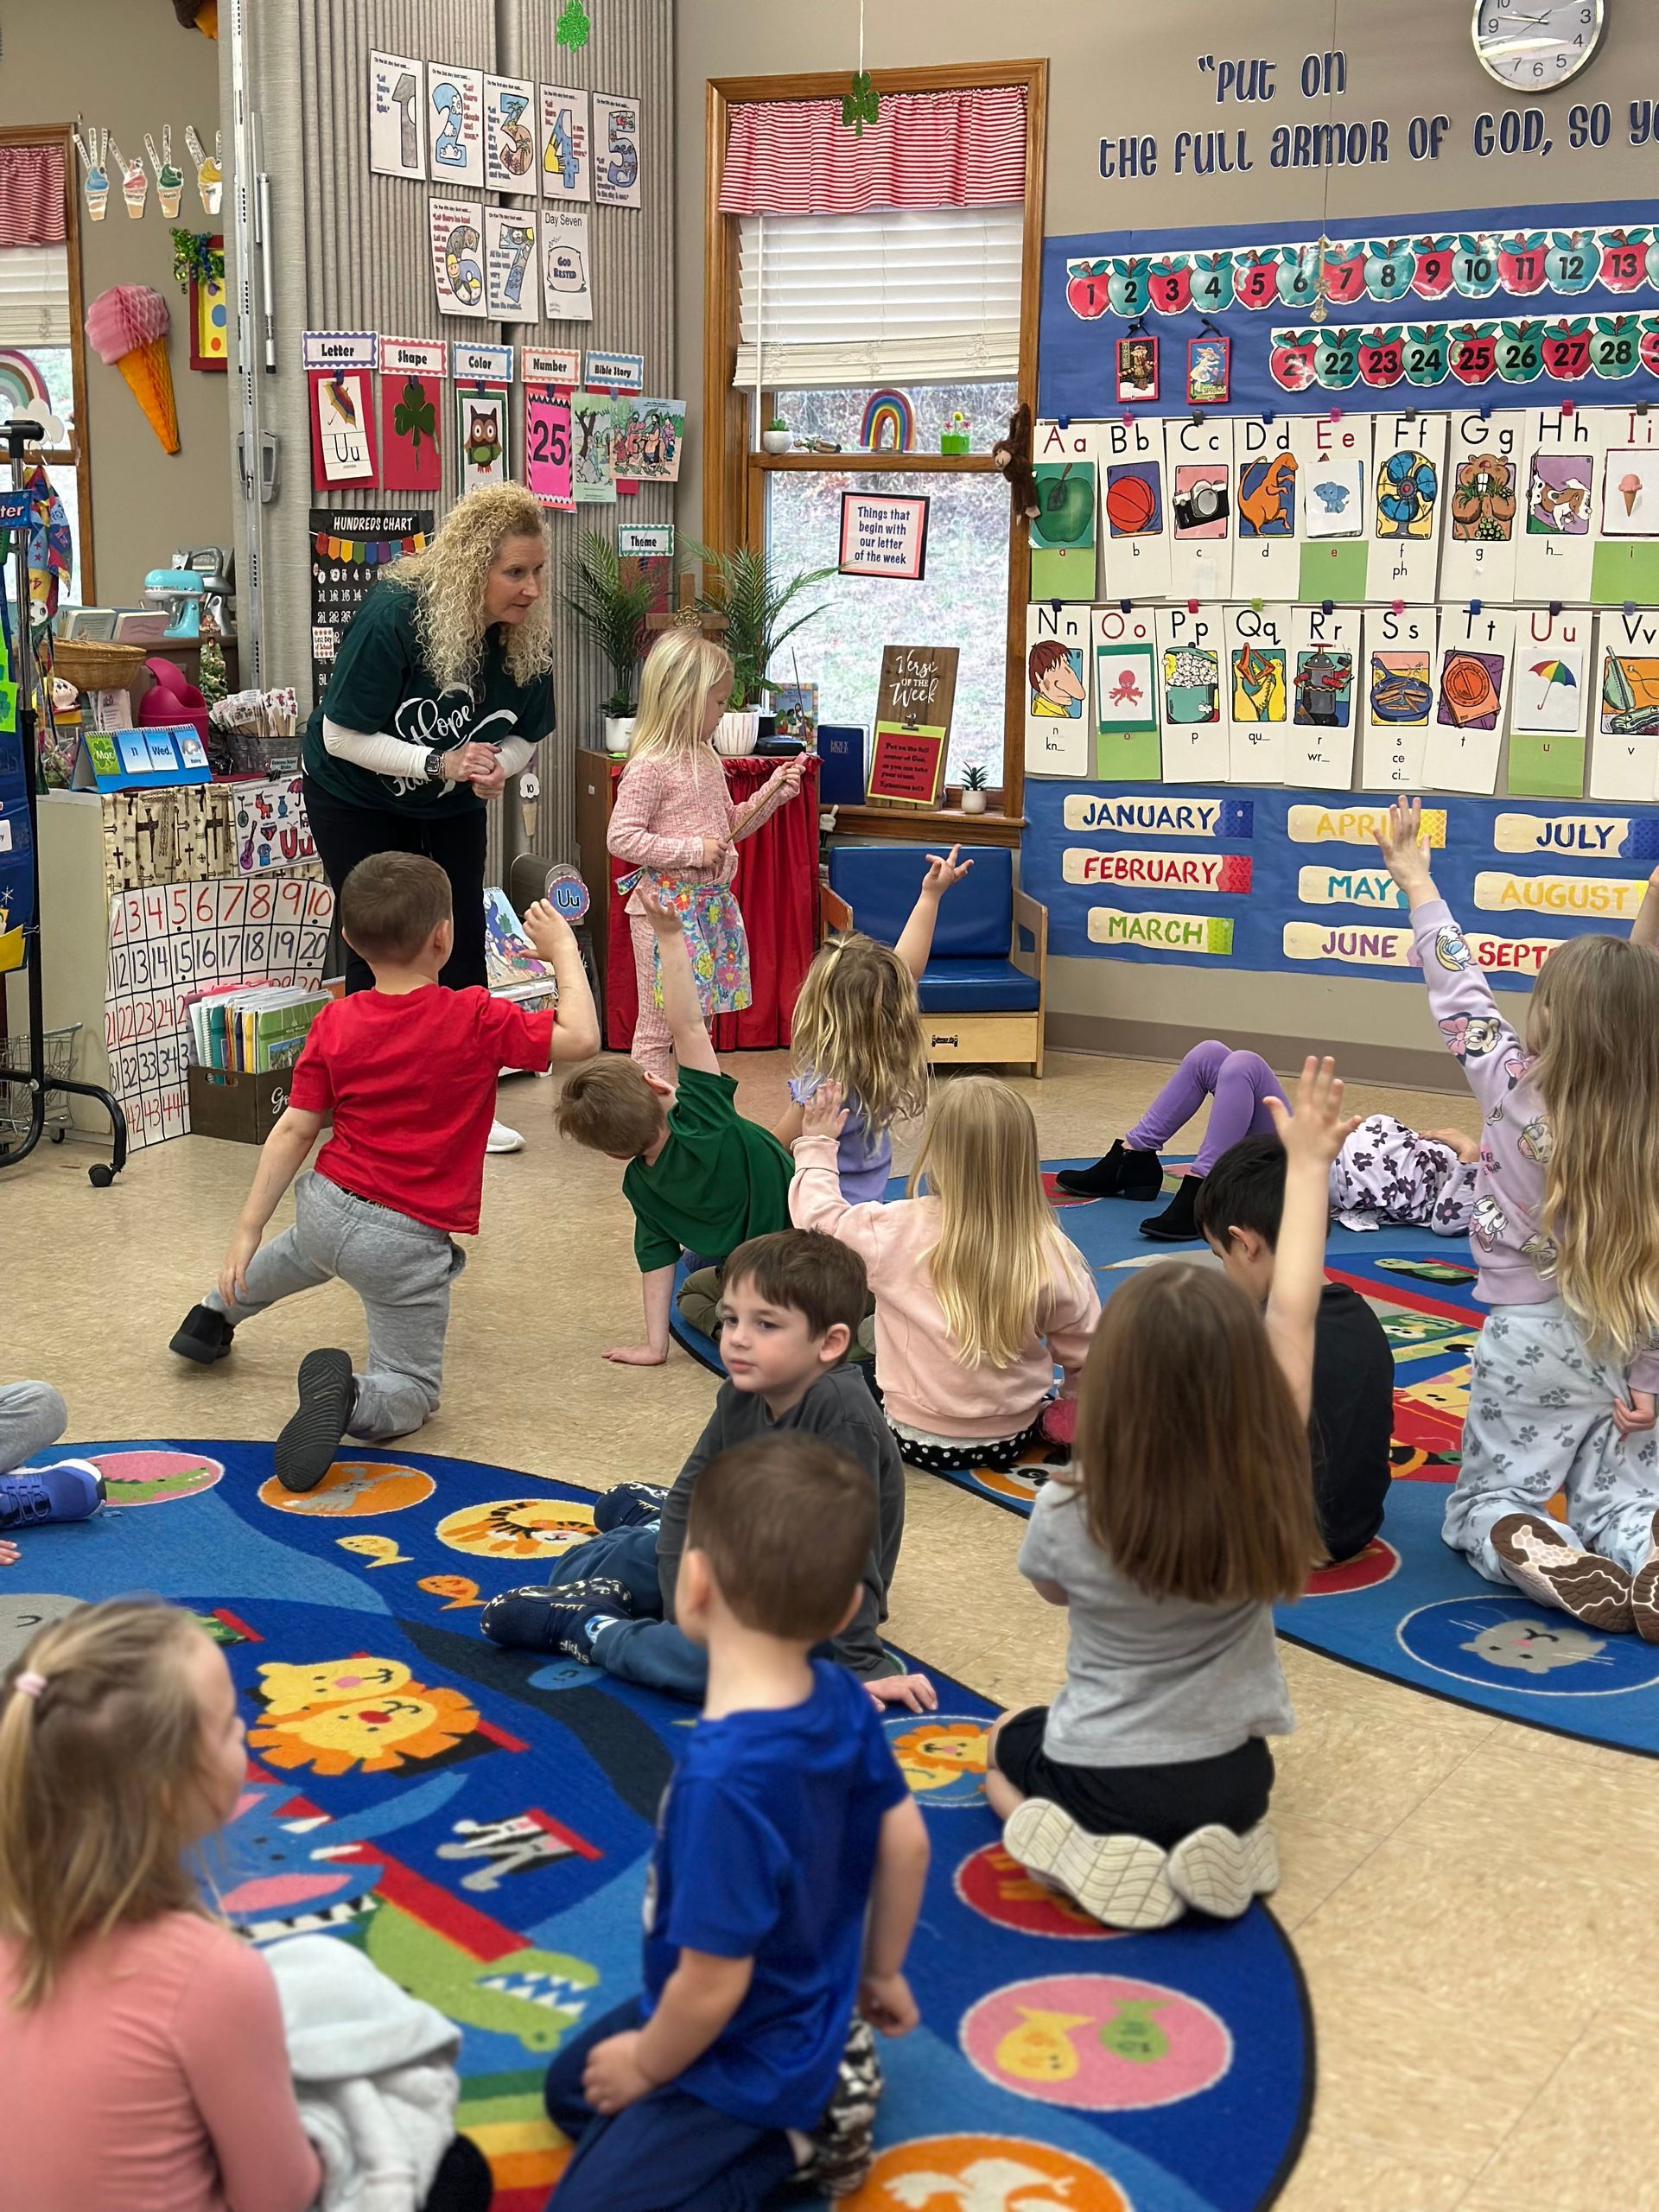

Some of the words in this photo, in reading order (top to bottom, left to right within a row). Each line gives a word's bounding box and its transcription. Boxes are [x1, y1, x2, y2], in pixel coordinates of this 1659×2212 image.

[1488, 18, 1499, 33] 9
[1580, 9, 1592, 23] 3
[1573, 34, 1583, 48] 4
[1512, 57, 1522, 72] 7
[1533, 62, 1543, 77] 6
[1556, 54, 1567, 67] 5
[391, 72, 419, 168] 1
[432, 83, 467, 168] 2
[499, 92, 534, 175] 3
[544, 109, 580, 188] 4
[607, 111, 638, 188] 5
[545, 212, 558, 226] Day
[560, 214, 582, 227] Seven
[446, 226, 483, 306] 6
[499, 223, 535, 303] 7
[1426, 259, 1440, 283] 9
[1465, 258, 1492, 283] 10
[1516, 257, 1535, 281] 11
[1559, 256, 1585, 280] 12
[1612, 253, 1637, 278] 13
[1205, 276, 1222, 300] 4
[1250, 272, 1265, 296] 5
[1294, 271, 1308, 293] 6
[1339, 267, 1354, 290] 7
[1380, 264, 1395, 288] 8
[1086, 283, 1095, 306] 1
[1124, 281, 1138, 303] 2
[1166, 278, 1179, 302] 3
[321, 343, 355, 359] Letter
[397, 350, 428, 367] Shape
[468, 355, 492, 371] Color
[1368, 350, 1397, 374] 23
[1410, 349, 1440, 372] 24
[1459, 346, 1491, 371] 25
[1505, 345, 1536, 369] 26
[1554, 342, 1586, 366] 27
[1599, 340, 1632, 365] 28
[532, 358, 568, 373] Number
[594, 363, 612, 378] Bible
[613, 365, 632, 379] Story
[1324, 352, 1354, 376] 22
[533, 419, 566, 467] 25
[333, 516, 381, 531] HUNDREDS
[383, 517, 414, 531] CHART
[858, 506, 888, 520] Things
[890, 508, 910, 520] that
[859, 521, 883, 535] begin
[886, 524, 906, 536] with
[631, 535, 657, 547] Theme
[860, 537, 875, 548] our
[878, 537, 903, 550] letter
[1133, 542, 1141, 557] b
[1196, 548, 1203, 557] c
[1262, 542, 1269, 557] d
[1400, 543, 1405, 558] f
[855, 550, 864, 561] of
[867, 550, 881, 562] the
[883, 553, 906, 564] week
[1476, 548, 1484, 561] g
[1392, 562, 1408, 580] ph
[895, 649, 938, 677] Verse
[889, 677, 939, 709] Week
[901, 678, 912, 688] OF
[913, 678, 929, 688] THE
[1192, 731, 1198, 744] p
[1318, 735, 1323, 745] r
[1396, 738, 1402, 747] s
[1461, 736, 1466, 747] t
[1543, 744, 1550, 753] u
[96, 748, 115, 761] Mar.
[152, 745, 173, 757] Wed.
[1392, 753, 1405, 763] ce
[1627, 747, 1635, 755] v
[526, 784, 535, 793] 10
[1082, 803, 1215, 830] JANUARY
[1536, 822, 1617, 851] JULY
[1083, 856, 1218, 885] FEBRUARY
[282, 882, 302, 916] 9
[1327, 875, 1391, 901] MAY
[1500, 880, 1631, 912] AUGUST
[171, 889, 188, 925] 5
[196, 887, 213, 922] 6
[222, 886, 244, 922] 7
[250, 883, 270, 918] 8
[306, 887, 332, 917] 10
[128, 900, 142, 933] 3
[147, 895, 162, 931] 4
[1108, 915, 1205, 946] MARCH
[197, 936, 216, 969] 16
[221, 934, 241, 968] 17
[244, 931, 264, 963] 18
[273, 931, 295, 960] 19
[299, 930, 329, 961] 20
[1321, 931, 1398, 958] JUNE
[115, 952, 129, 988] 12
[131, 949, 149, 984] 13
[151, 945, 168, 979] 14
[174, 940, 193, 976] 15
[118, 1006, 135, 1042] 22
[136, 1001, 154, 1038] 23
[156, 997, 175, 1031] 24
[122, 1057, 138, 1090] 32
[139, 1052, 157, 1083] 33
[159, 1046, 178, 1078] 34
[143, 1098, 161, 1128] 43
